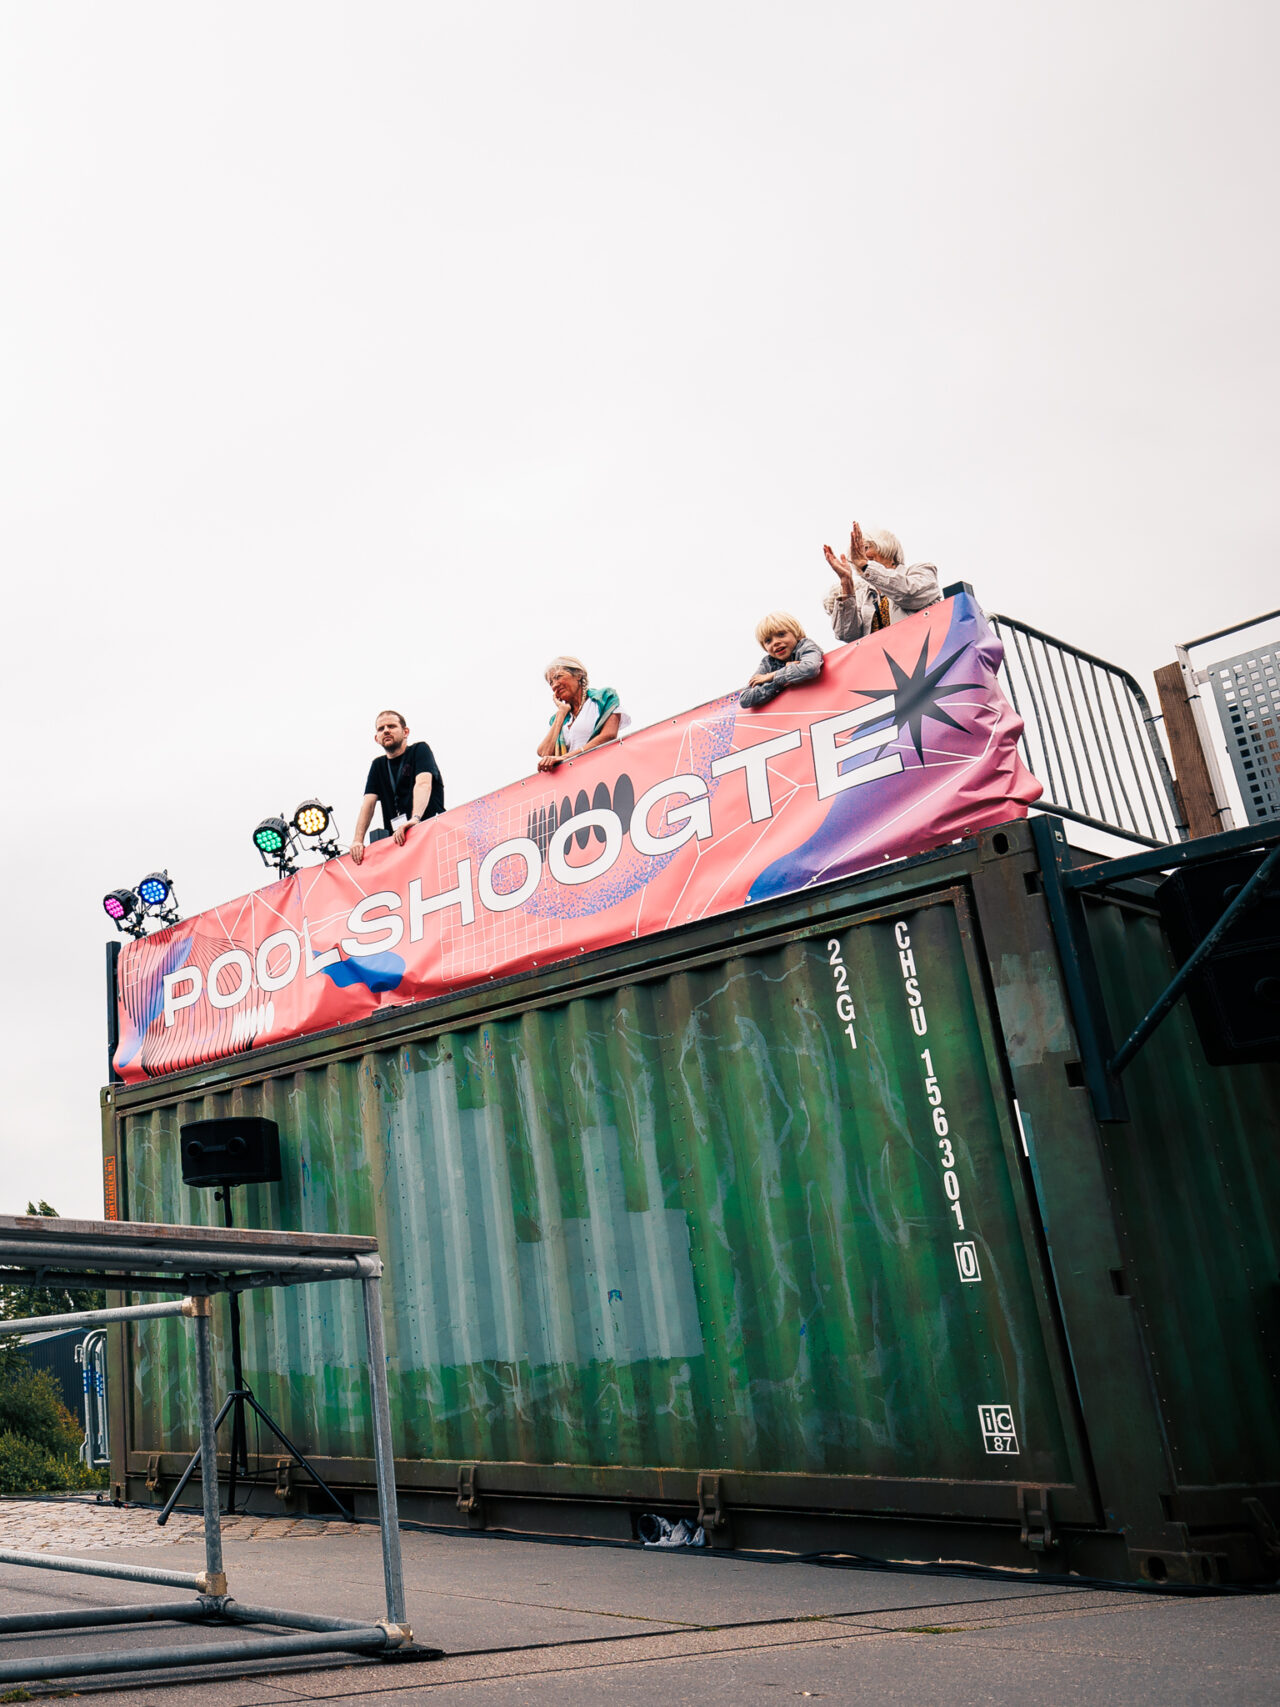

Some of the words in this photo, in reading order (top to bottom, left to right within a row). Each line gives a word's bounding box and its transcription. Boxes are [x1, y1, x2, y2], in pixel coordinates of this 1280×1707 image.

[162, 694, 904, 1028] POOLSHOOGTE
[827, 938, 857, 1050] 22G1
[894, 921, 928, 1036] CHSU
[920, 1048, 965, 1231] 156301
[993, 1436, 1012, 1451] 87
